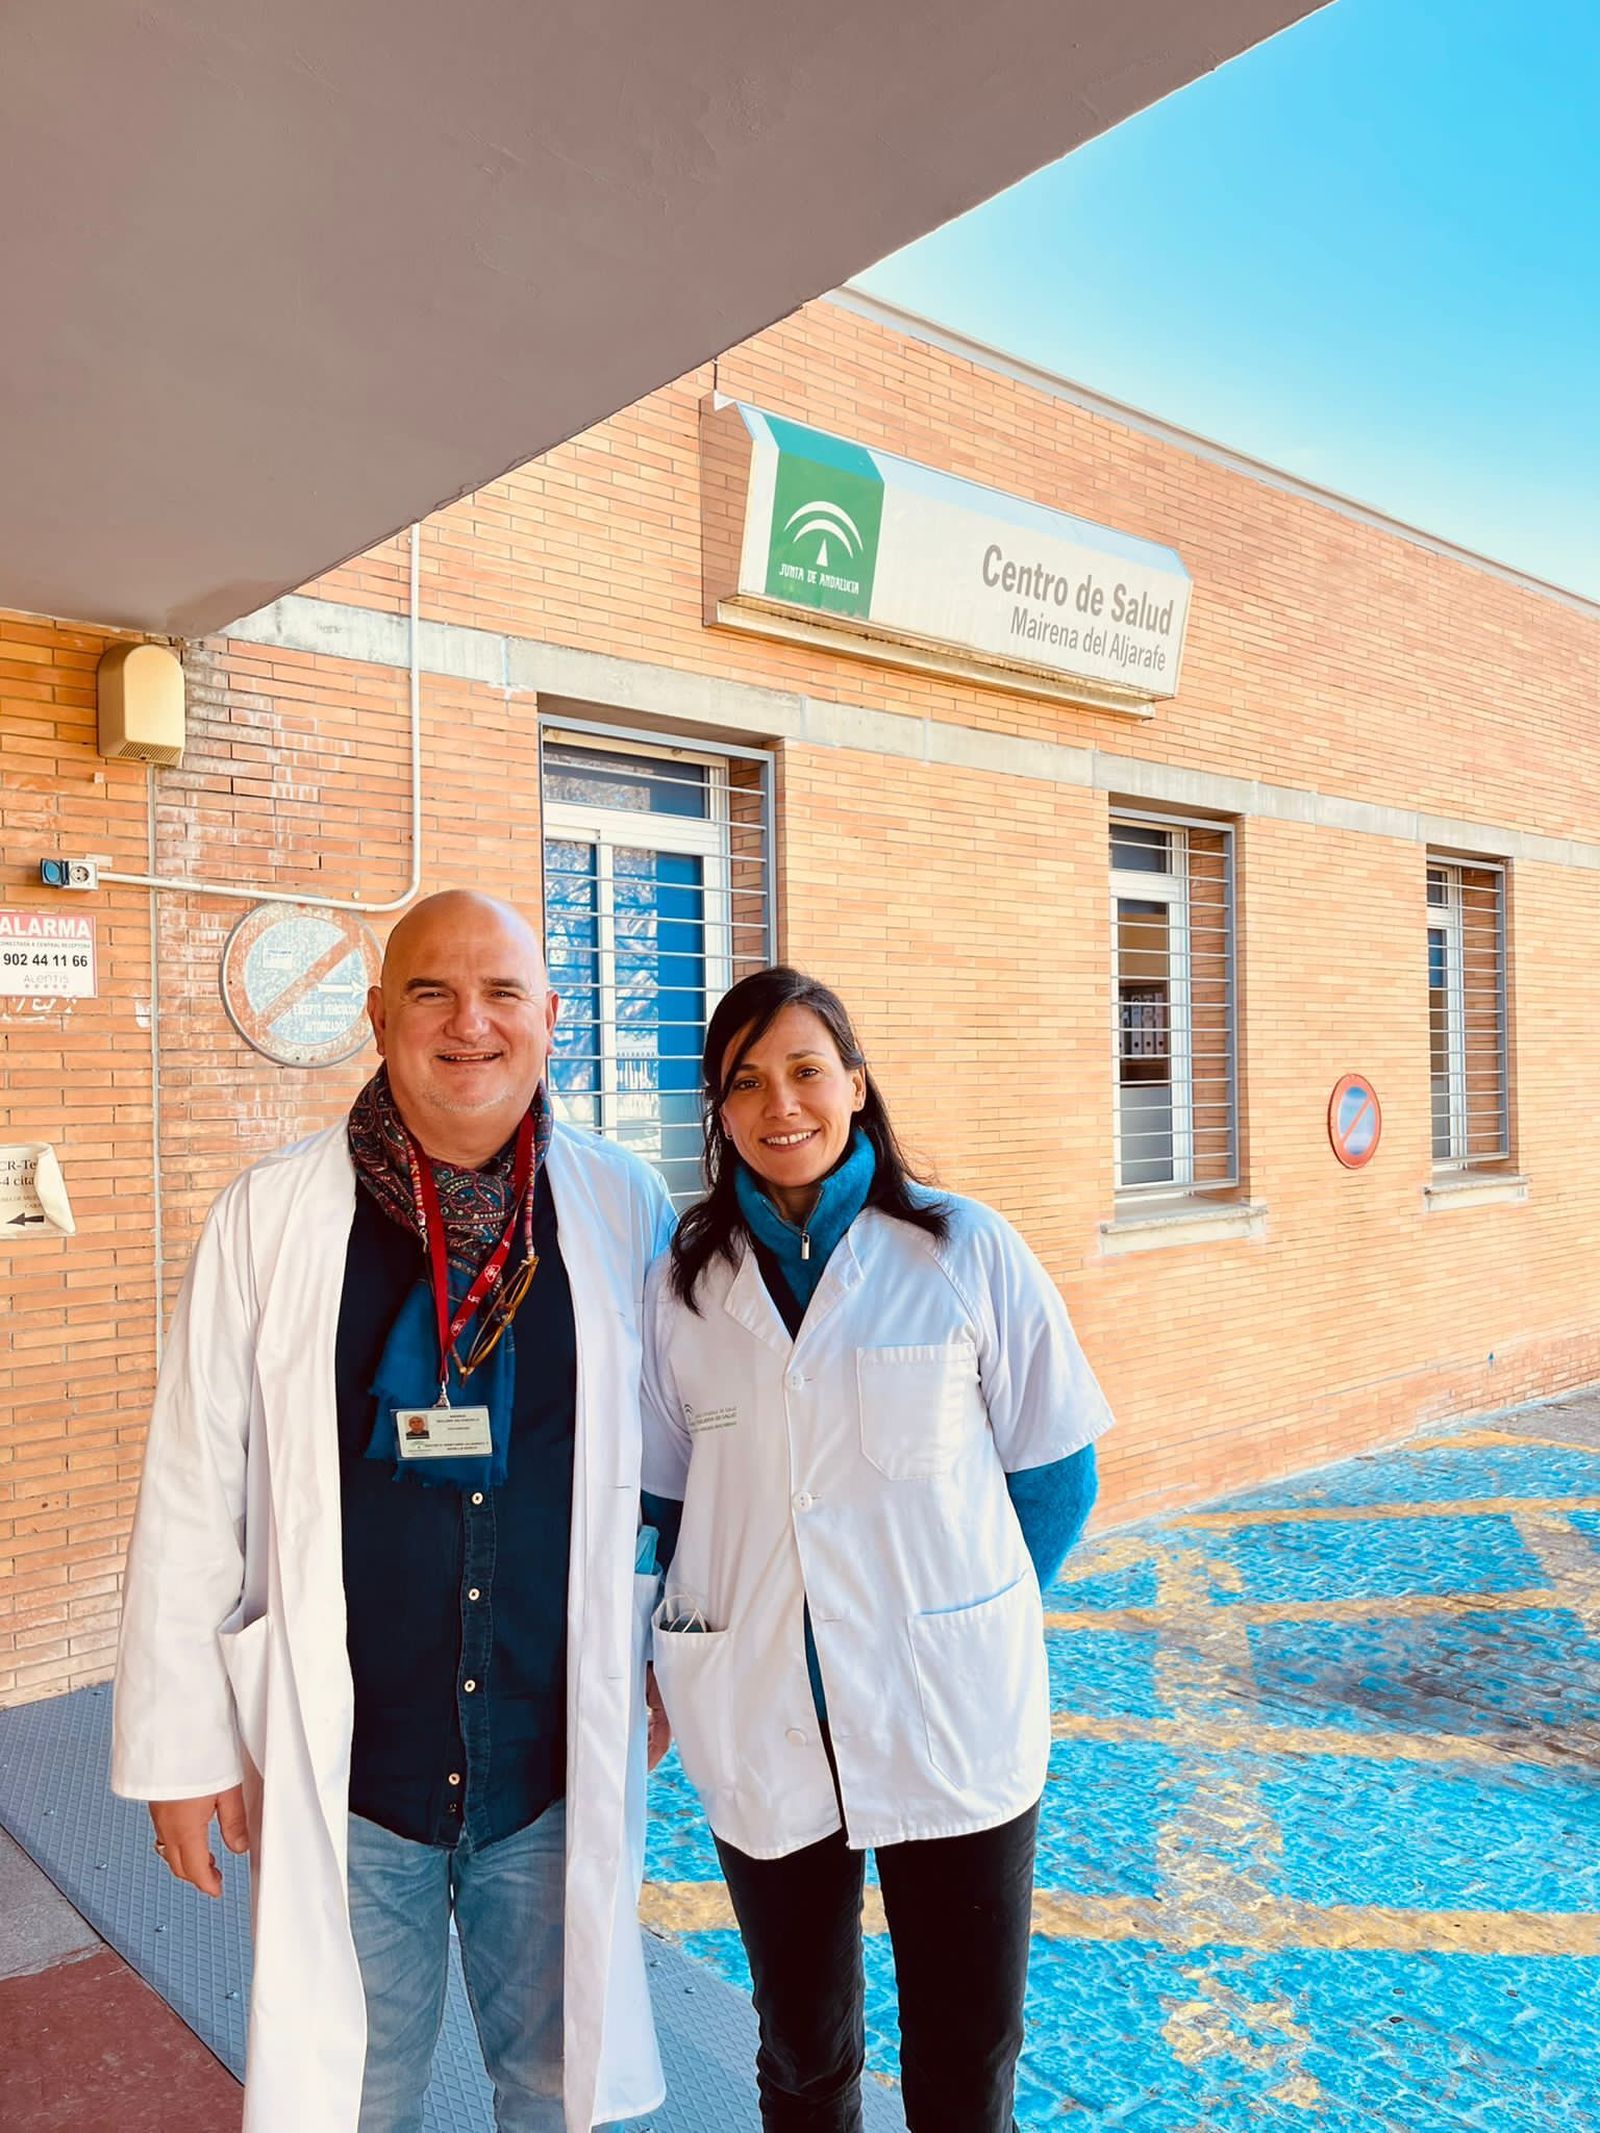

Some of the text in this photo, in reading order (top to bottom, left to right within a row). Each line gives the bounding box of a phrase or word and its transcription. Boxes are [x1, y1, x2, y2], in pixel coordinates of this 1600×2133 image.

[779, 563, 860, 596] JUNTA DE ANDALUCIA
[982, 544, 1175, 636] Centro de Salud
[1010, 605, 1166, 672] Mairena del Aljarafe
[0, 916, 92, 938] ALARMA
[3, 953, 88, 968] 902 44 11 66
